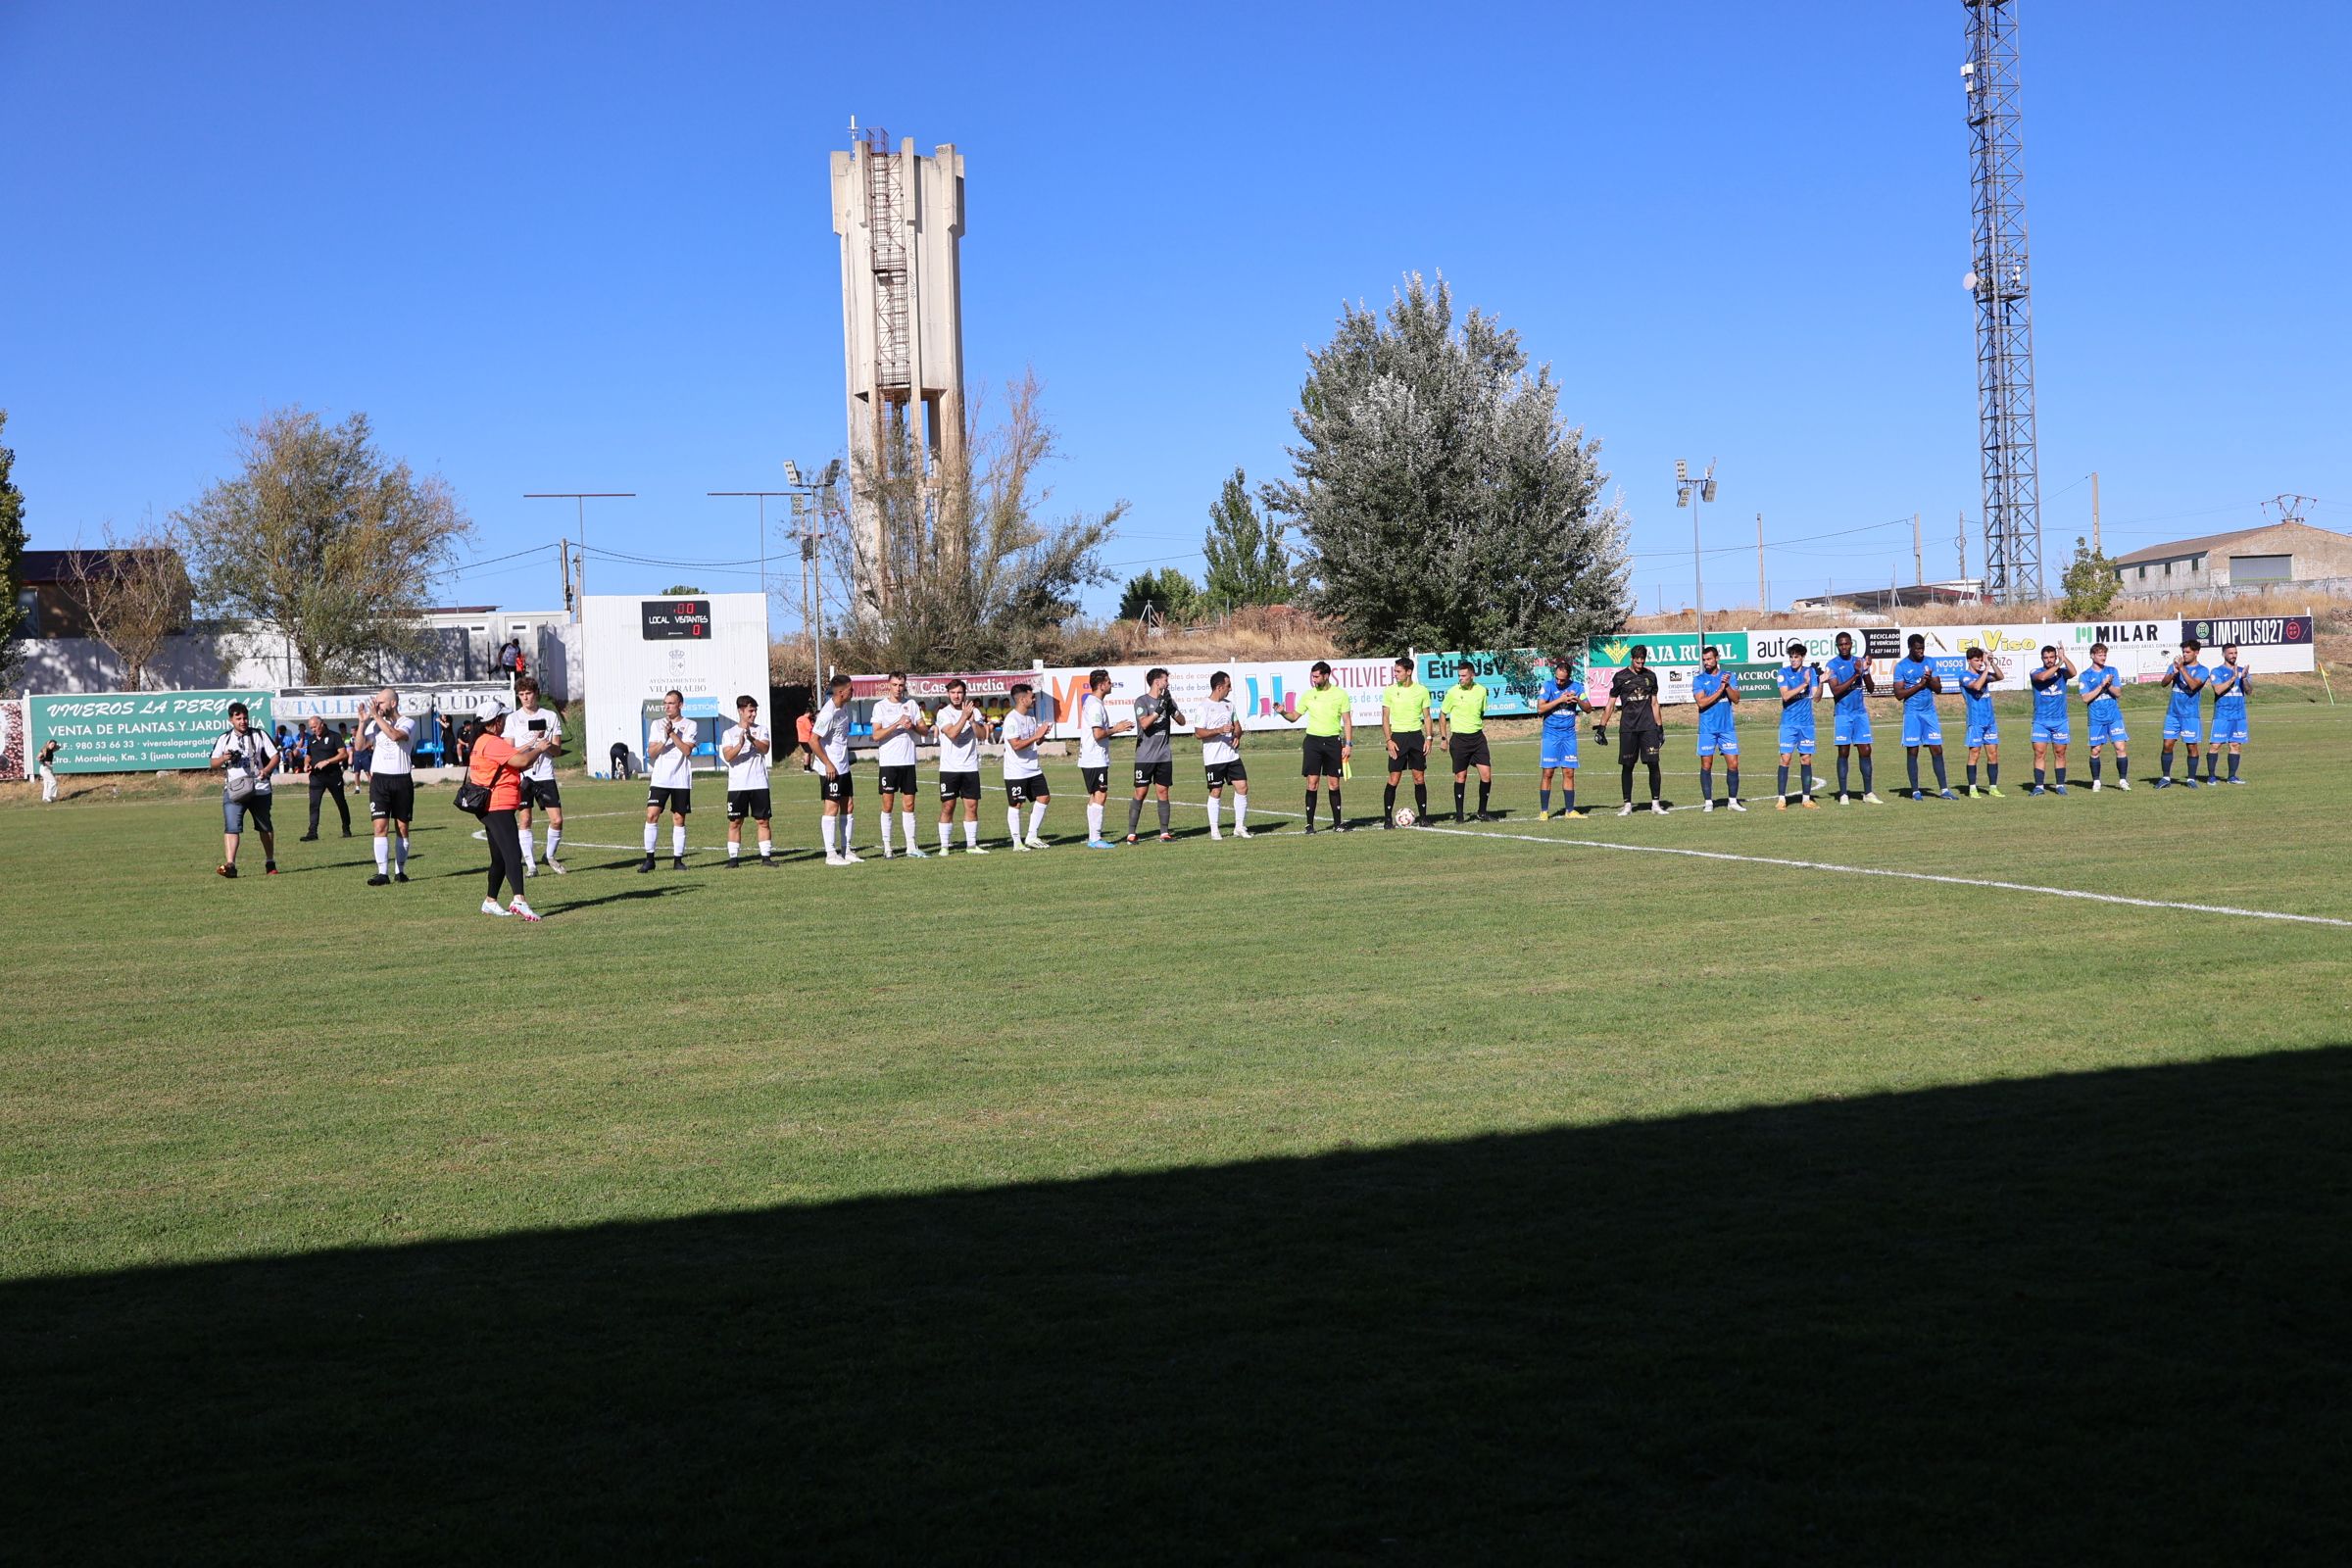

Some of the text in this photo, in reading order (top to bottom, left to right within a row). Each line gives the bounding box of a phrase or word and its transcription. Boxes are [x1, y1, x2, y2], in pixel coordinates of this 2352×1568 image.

[674, 615, 709, 624] VISITANTES
[693, 624, 701, 635] 0
[2095, 624, 2159, 643] MILAR
[2213, 619, 2284, 645] IMPULSO27
[1644, 646, 1676, 663] AJA
[46, 702, 135, 717] VIVEROS
[139, 699, 169, 714] LA
[48, 725, 93, 737] VENTA
[97, 724, 114, 734] DE
[118, 721, 175, 734] PLANTAS
[178, 721, 189, 731] Y
[75, 741, 92, 750] 980
[95, 741, 107, 750] 53
[75, 753, 119, 764] Moraleja,
[122, 752, 138, 761] Km.
[150, 751, 174, 761] (junto
[829, 782, 839, 793] 10
[1011, 787, 1022, 796] 23
